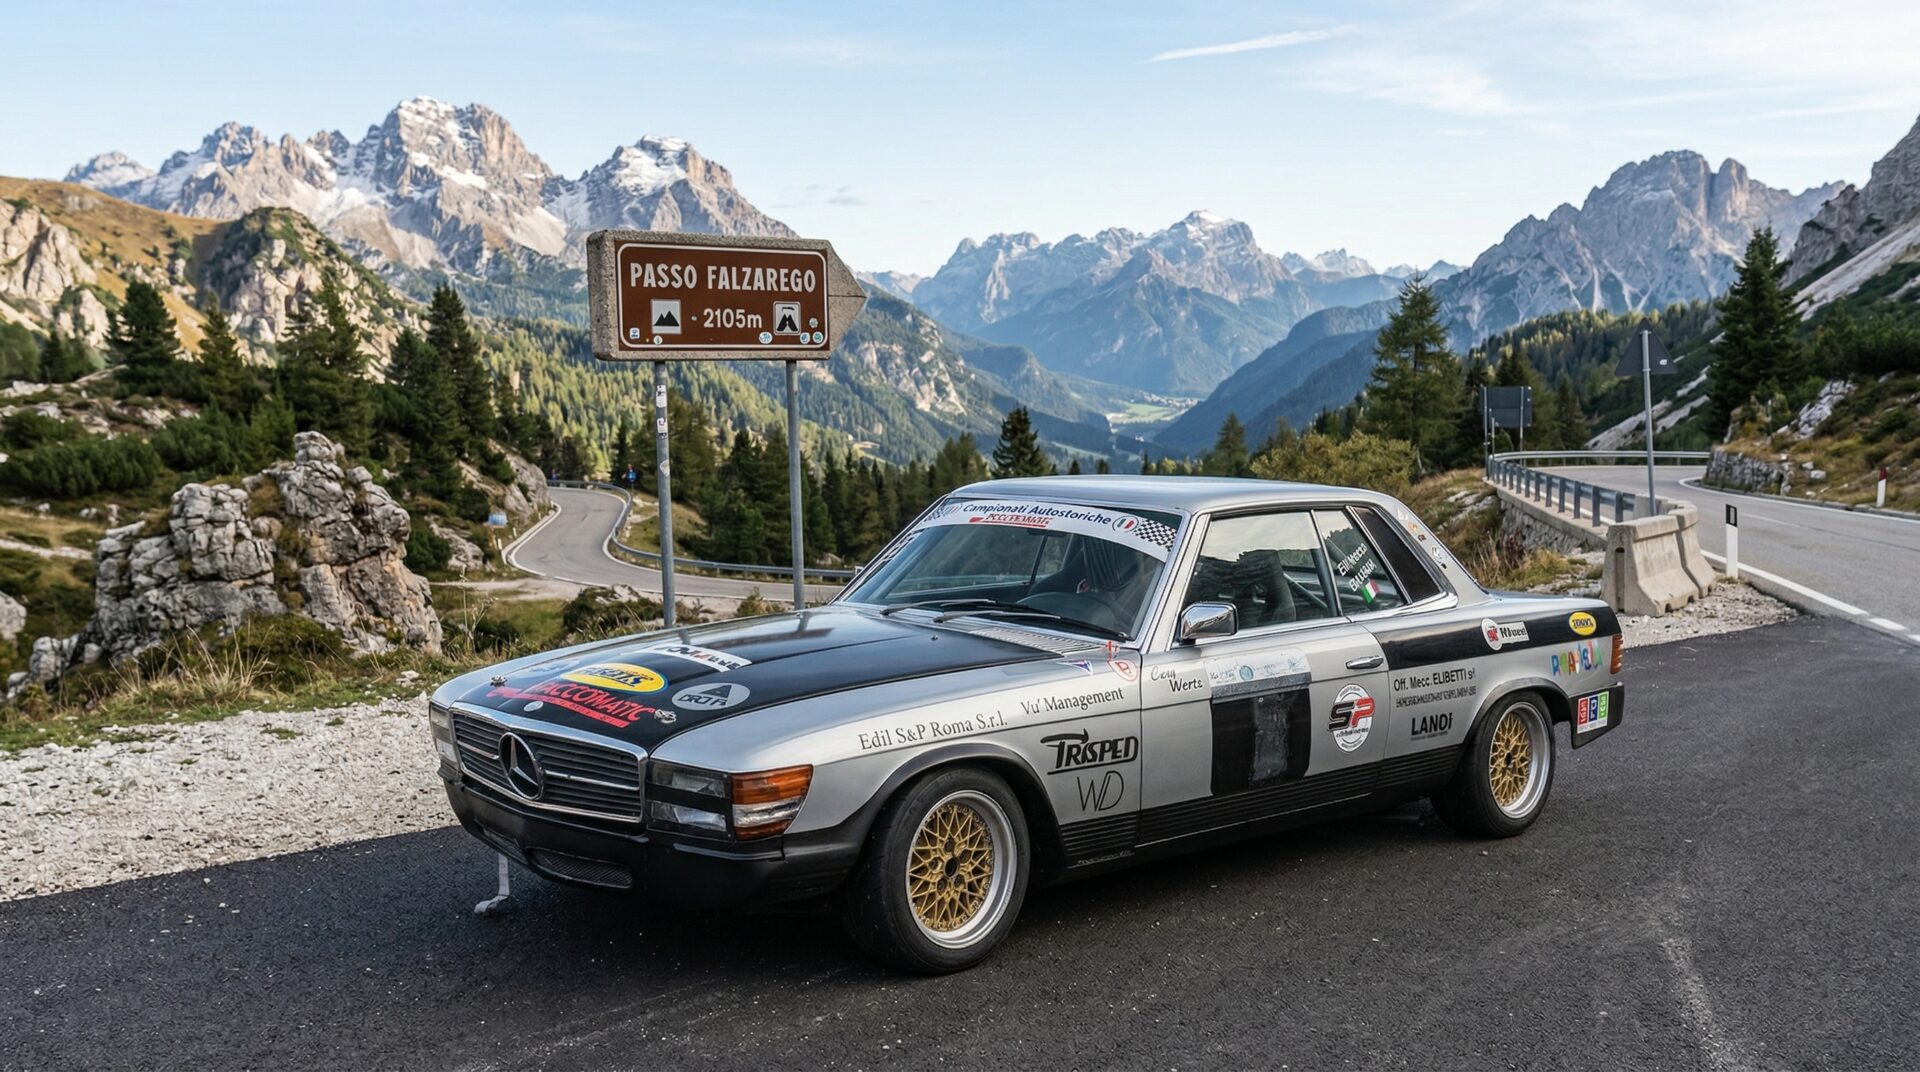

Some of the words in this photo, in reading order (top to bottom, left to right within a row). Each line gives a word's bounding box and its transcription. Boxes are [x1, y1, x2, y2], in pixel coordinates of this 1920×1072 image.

[630, 262, 697, 289] PASSO
[707, 265, 816, 293] FALZAREGO
[703, 308, 762, 329] 2105m
[963, 503, 1029, 514] Campionati
[1027, 505, 1111, 525] Autostoriche
[1394, 679, 1408, 691] Off.
[1433, 668, 1467, 685] ELIBETTI
[1043, 687, 1124, 711] Management
[1328, 697, 1375, 731] SP
[858, 729, 893, 750] Edil
[896, 724, 926, 743] S&P
[929, 721, 974, 737] Roma
[975, 710, 1008, 729] S.r.l.
[1077, 770, 1124, 811] WD
